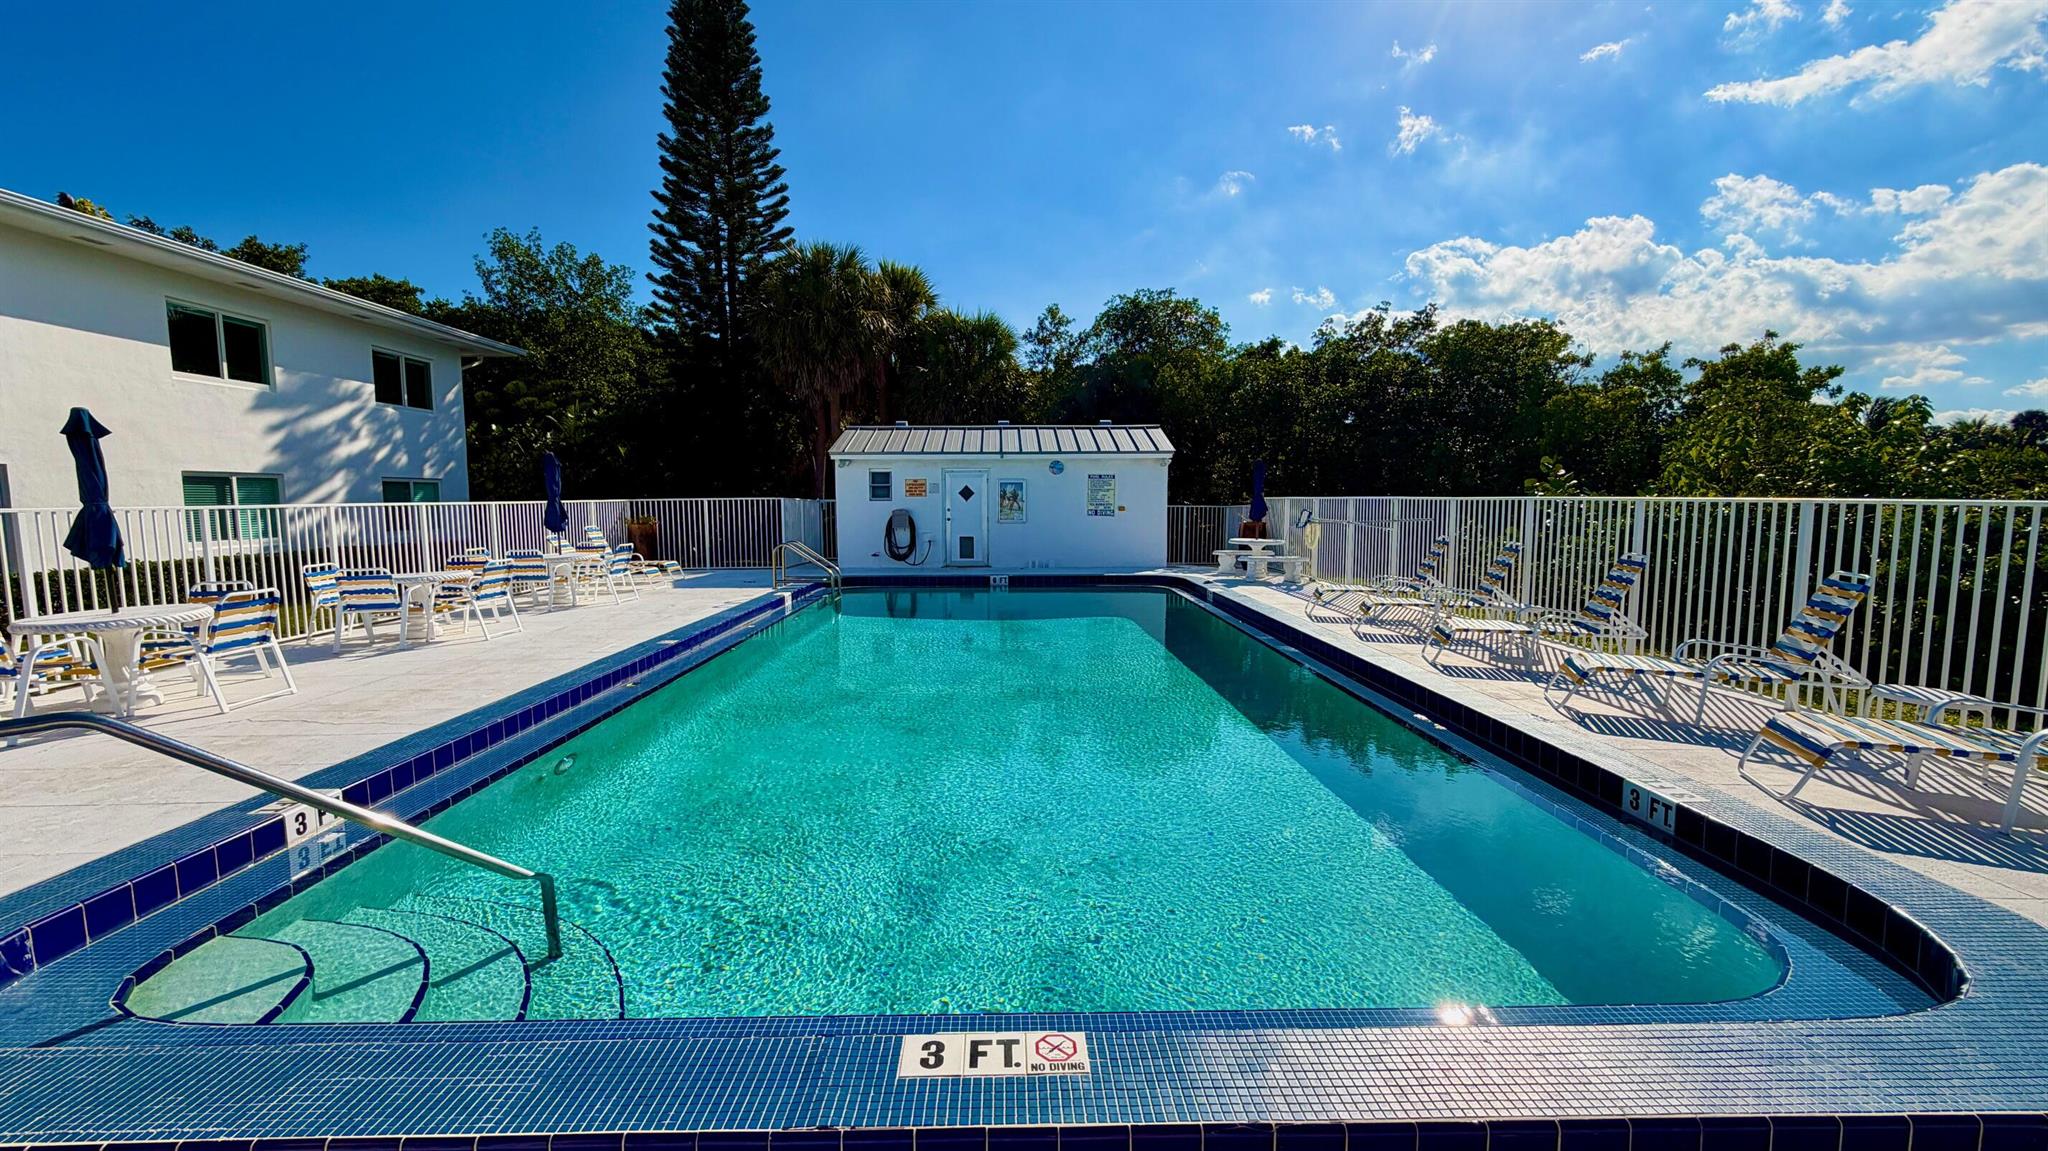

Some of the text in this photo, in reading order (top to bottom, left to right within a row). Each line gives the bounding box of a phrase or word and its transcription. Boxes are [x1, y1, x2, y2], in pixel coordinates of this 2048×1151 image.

[1629, 788, 1640, 811] 3
[1649, 796, 1673, 828] FT.
[294, 811, 307, 836] 3
[919, 1039, 1022, 1070] 3 FT.
[1030, 1061, 1086, 1072] NO DIVING
